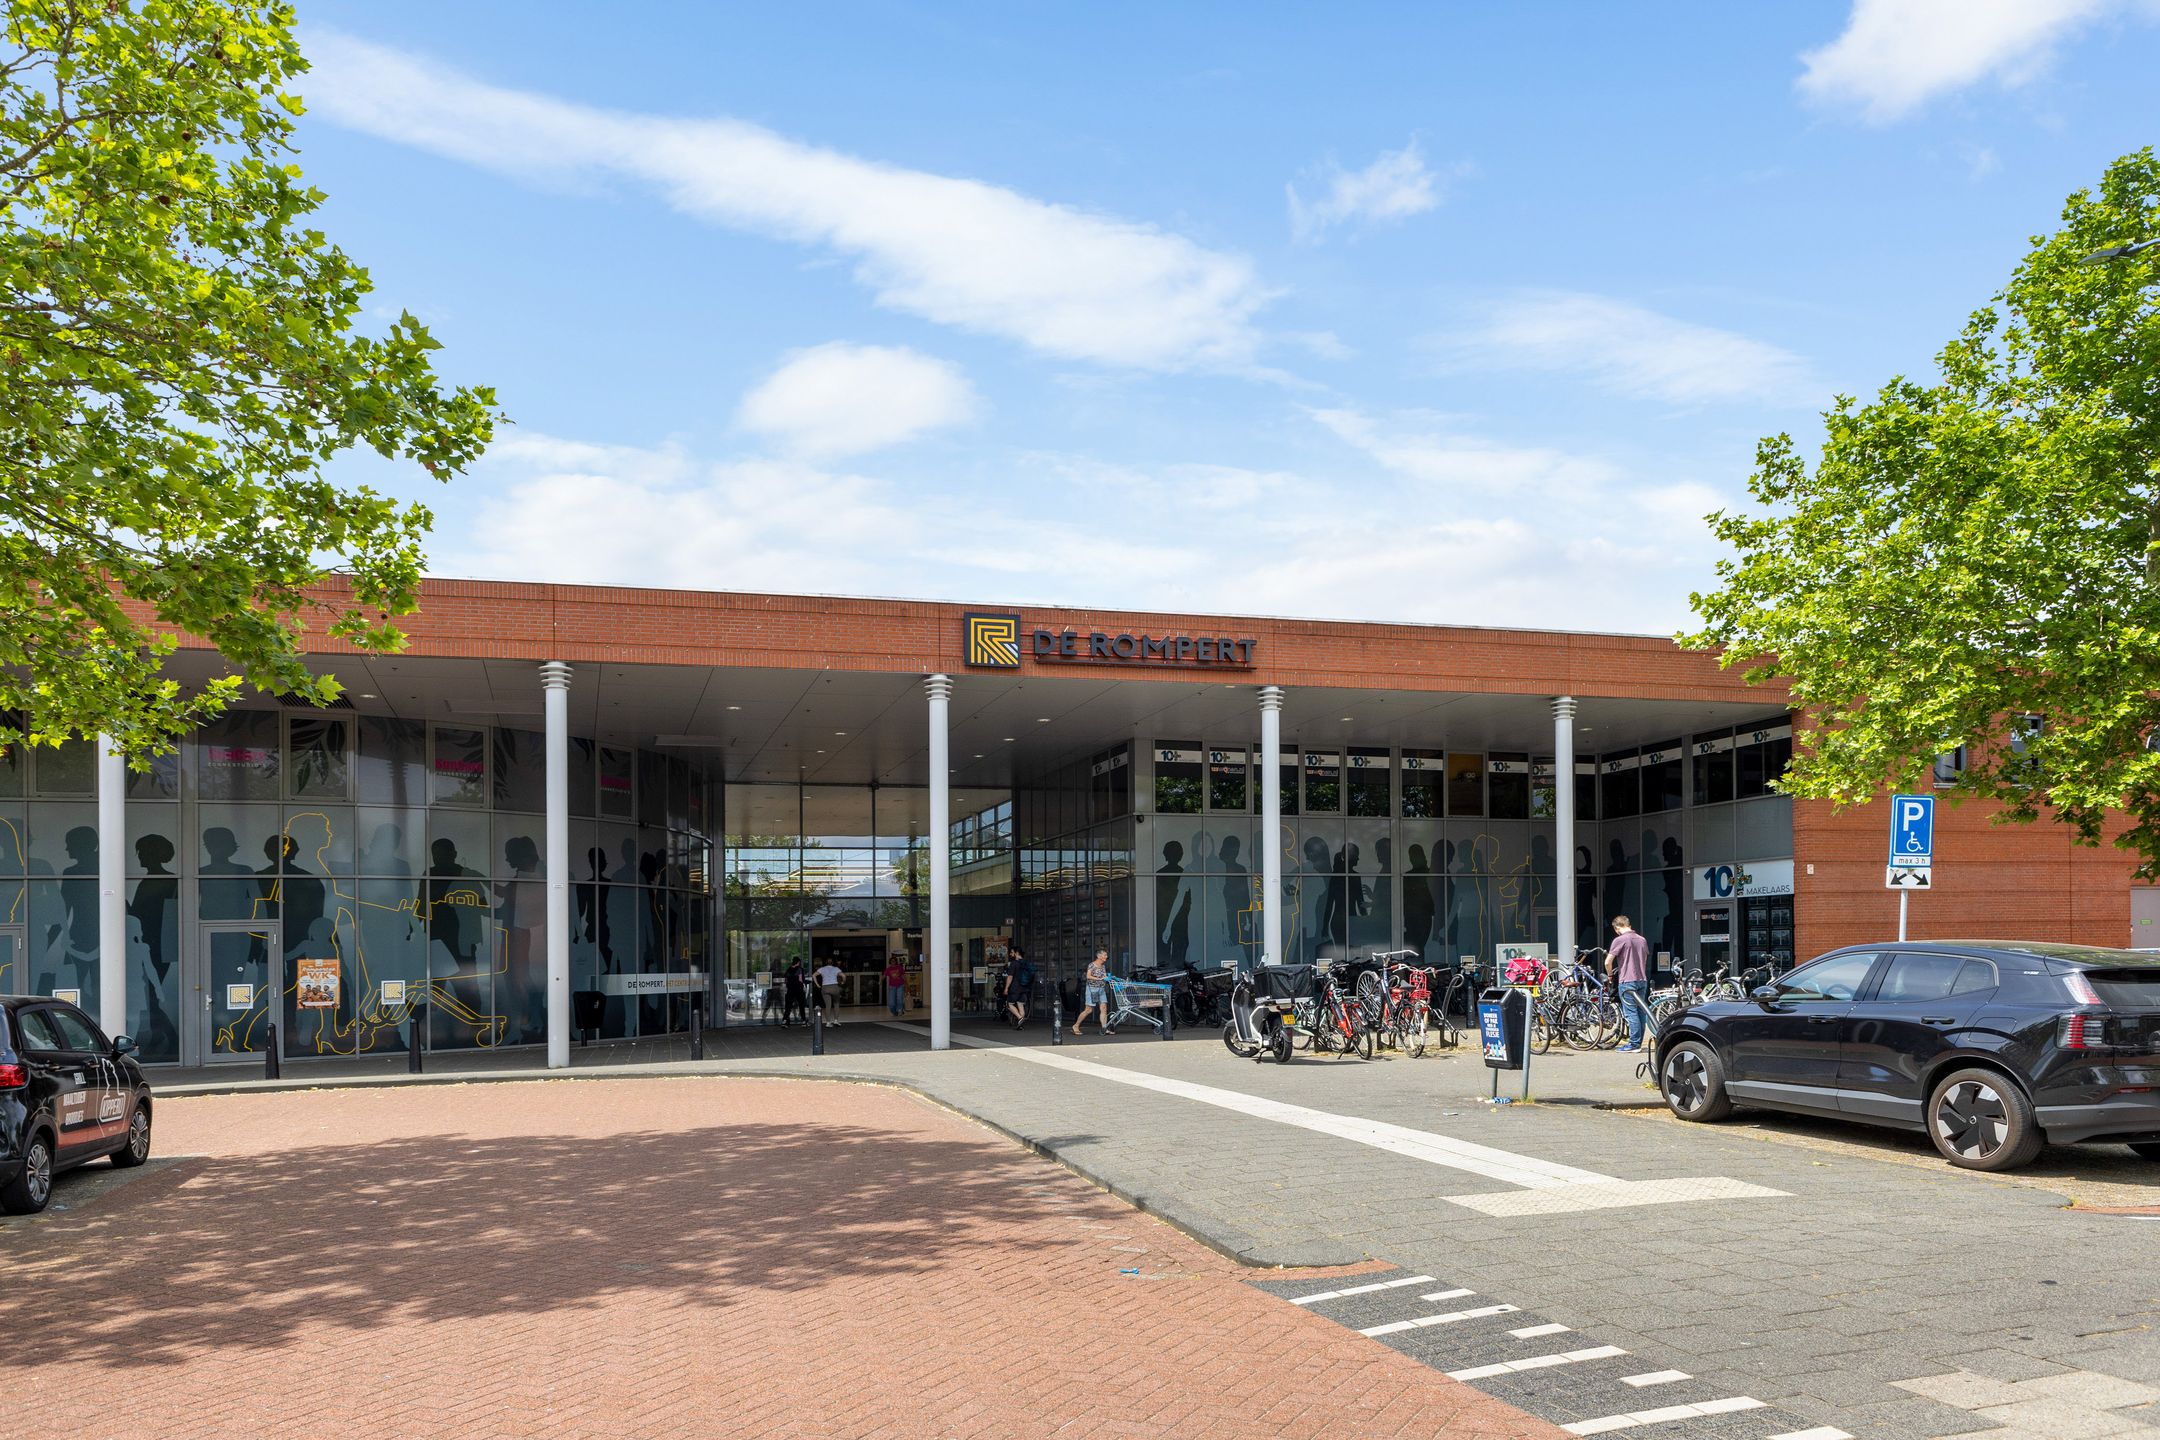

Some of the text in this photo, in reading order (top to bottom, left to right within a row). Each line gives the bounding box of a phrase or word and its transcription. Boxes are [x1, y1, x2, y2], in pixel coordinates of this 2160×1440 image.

[1034, 629, 1257, 663] DE ROMPERT
[1903, 802, 1924, 831] P
[1746, 885, 1791, 895] MAKELAARS
[628, 981, 637, 989] DE
